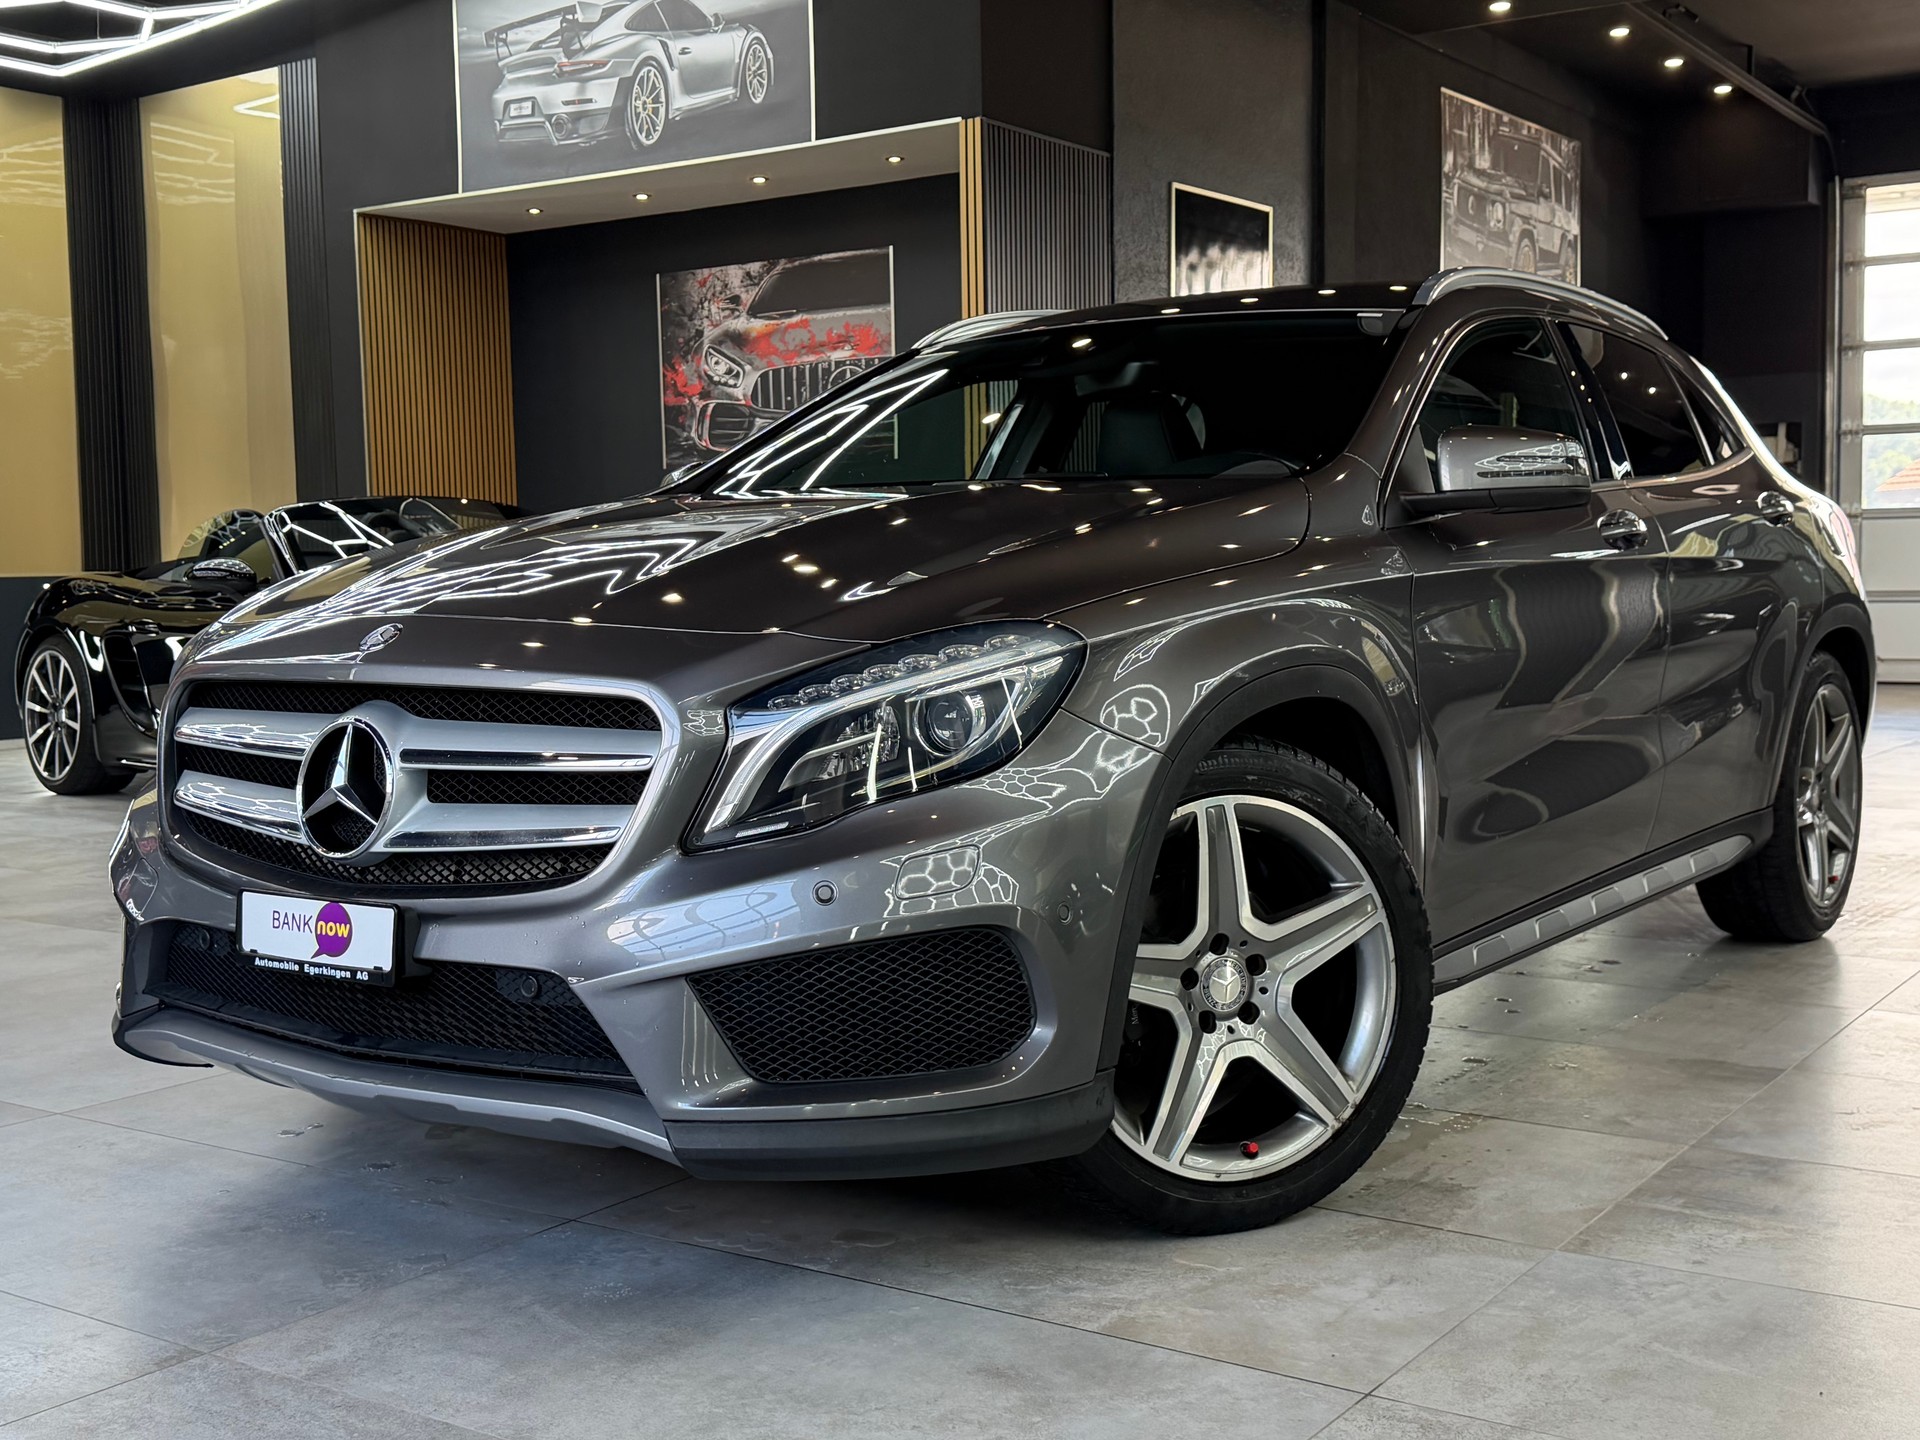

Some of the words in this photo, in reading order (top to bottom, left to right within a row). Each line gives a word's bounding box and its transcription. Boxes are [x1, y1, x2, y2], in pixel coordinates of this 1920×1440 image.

[272, 910, 313, 934] BANK
[317, 921, 350, 938] now
[254, 957, 300, 971] Automobile
[304, 964, 351, 979] Egerkingen
[356, 971, 369, 981] AG
